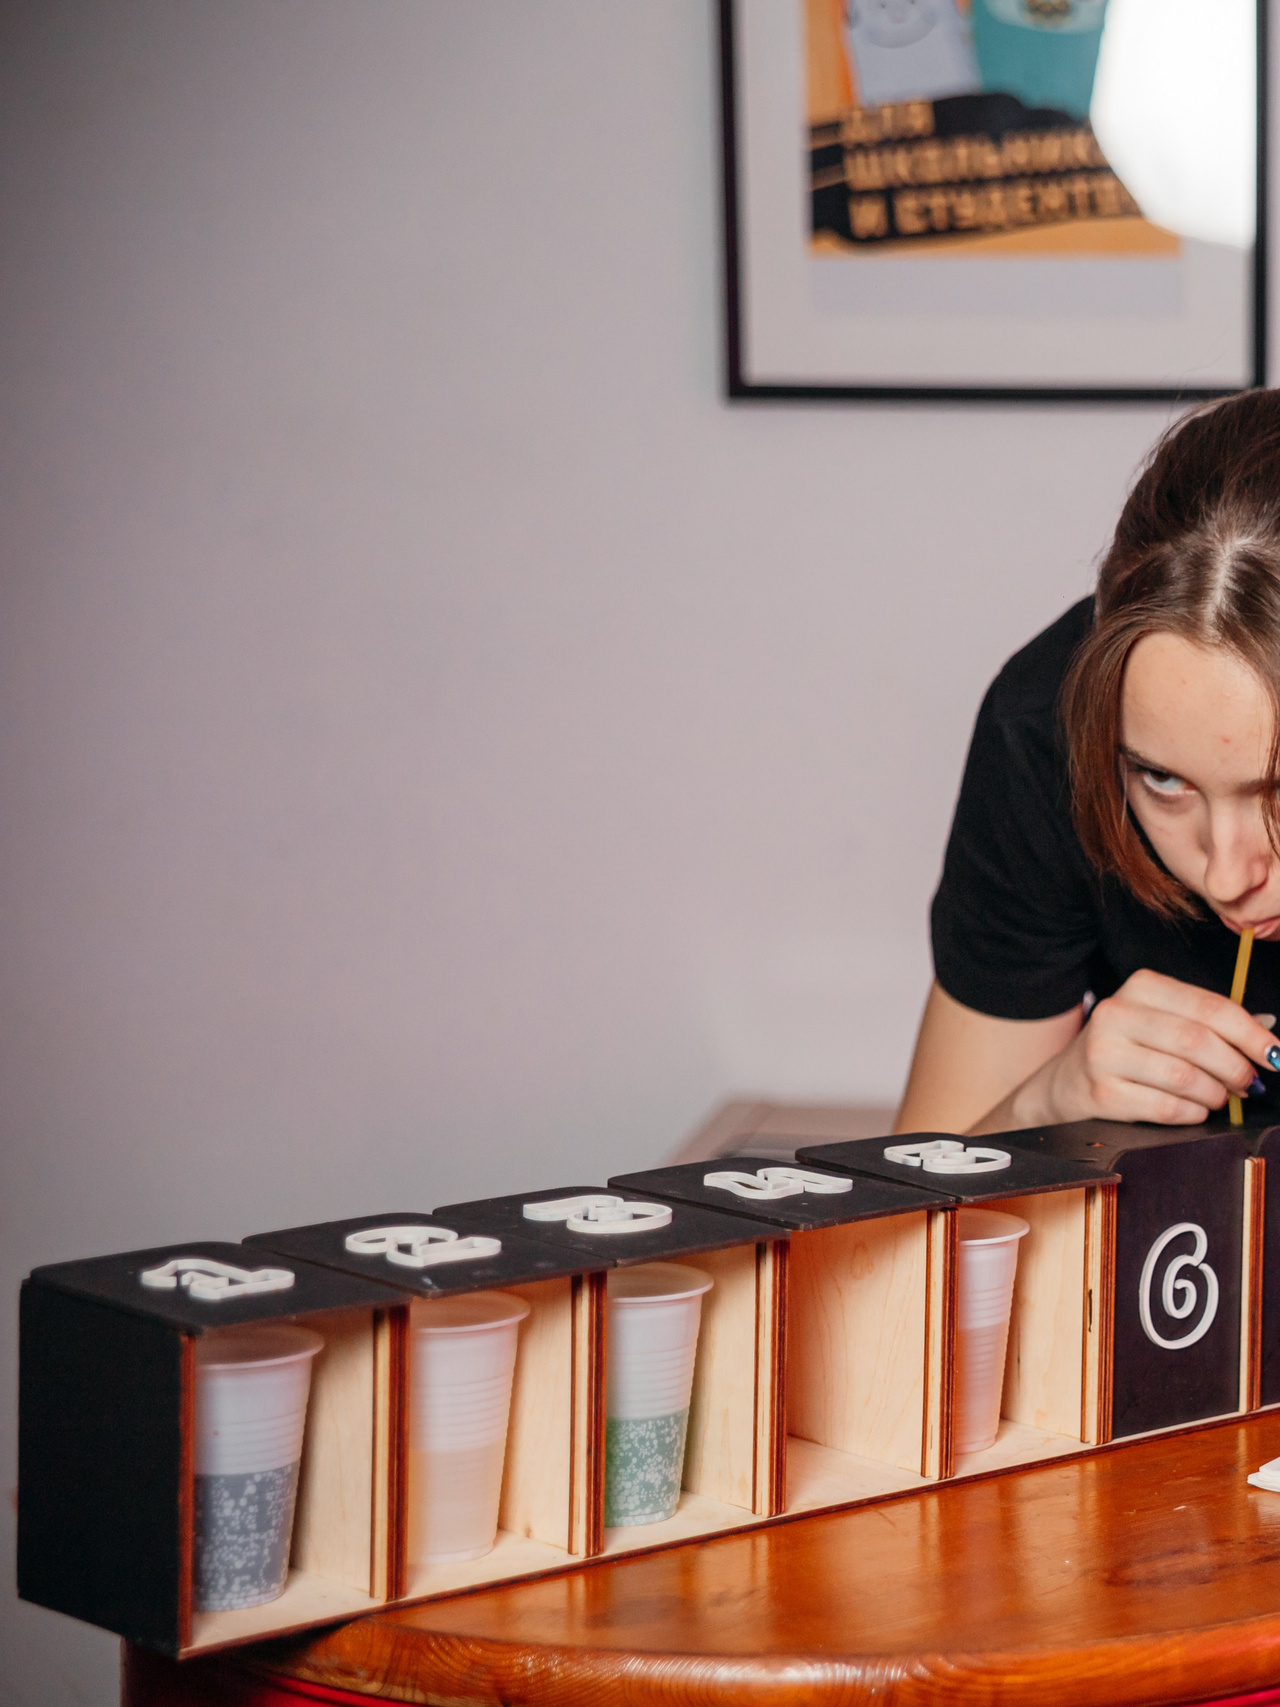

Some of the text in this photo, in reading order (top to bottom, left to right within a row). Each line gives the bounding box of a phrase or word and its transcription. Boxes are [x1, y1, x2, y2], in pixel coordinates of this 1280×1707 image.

[842, 100, 936, 143] ДЛЯ
[848, 196, 889, 240] И
[702, 1166, 854, 1200] 4
[522, 1194, 673, 1234] 3
[344, 1225, 502, 1268] 2
[140, 1258, 296, 1301] 1
[1139, 1222, 1219, 1350] 6
